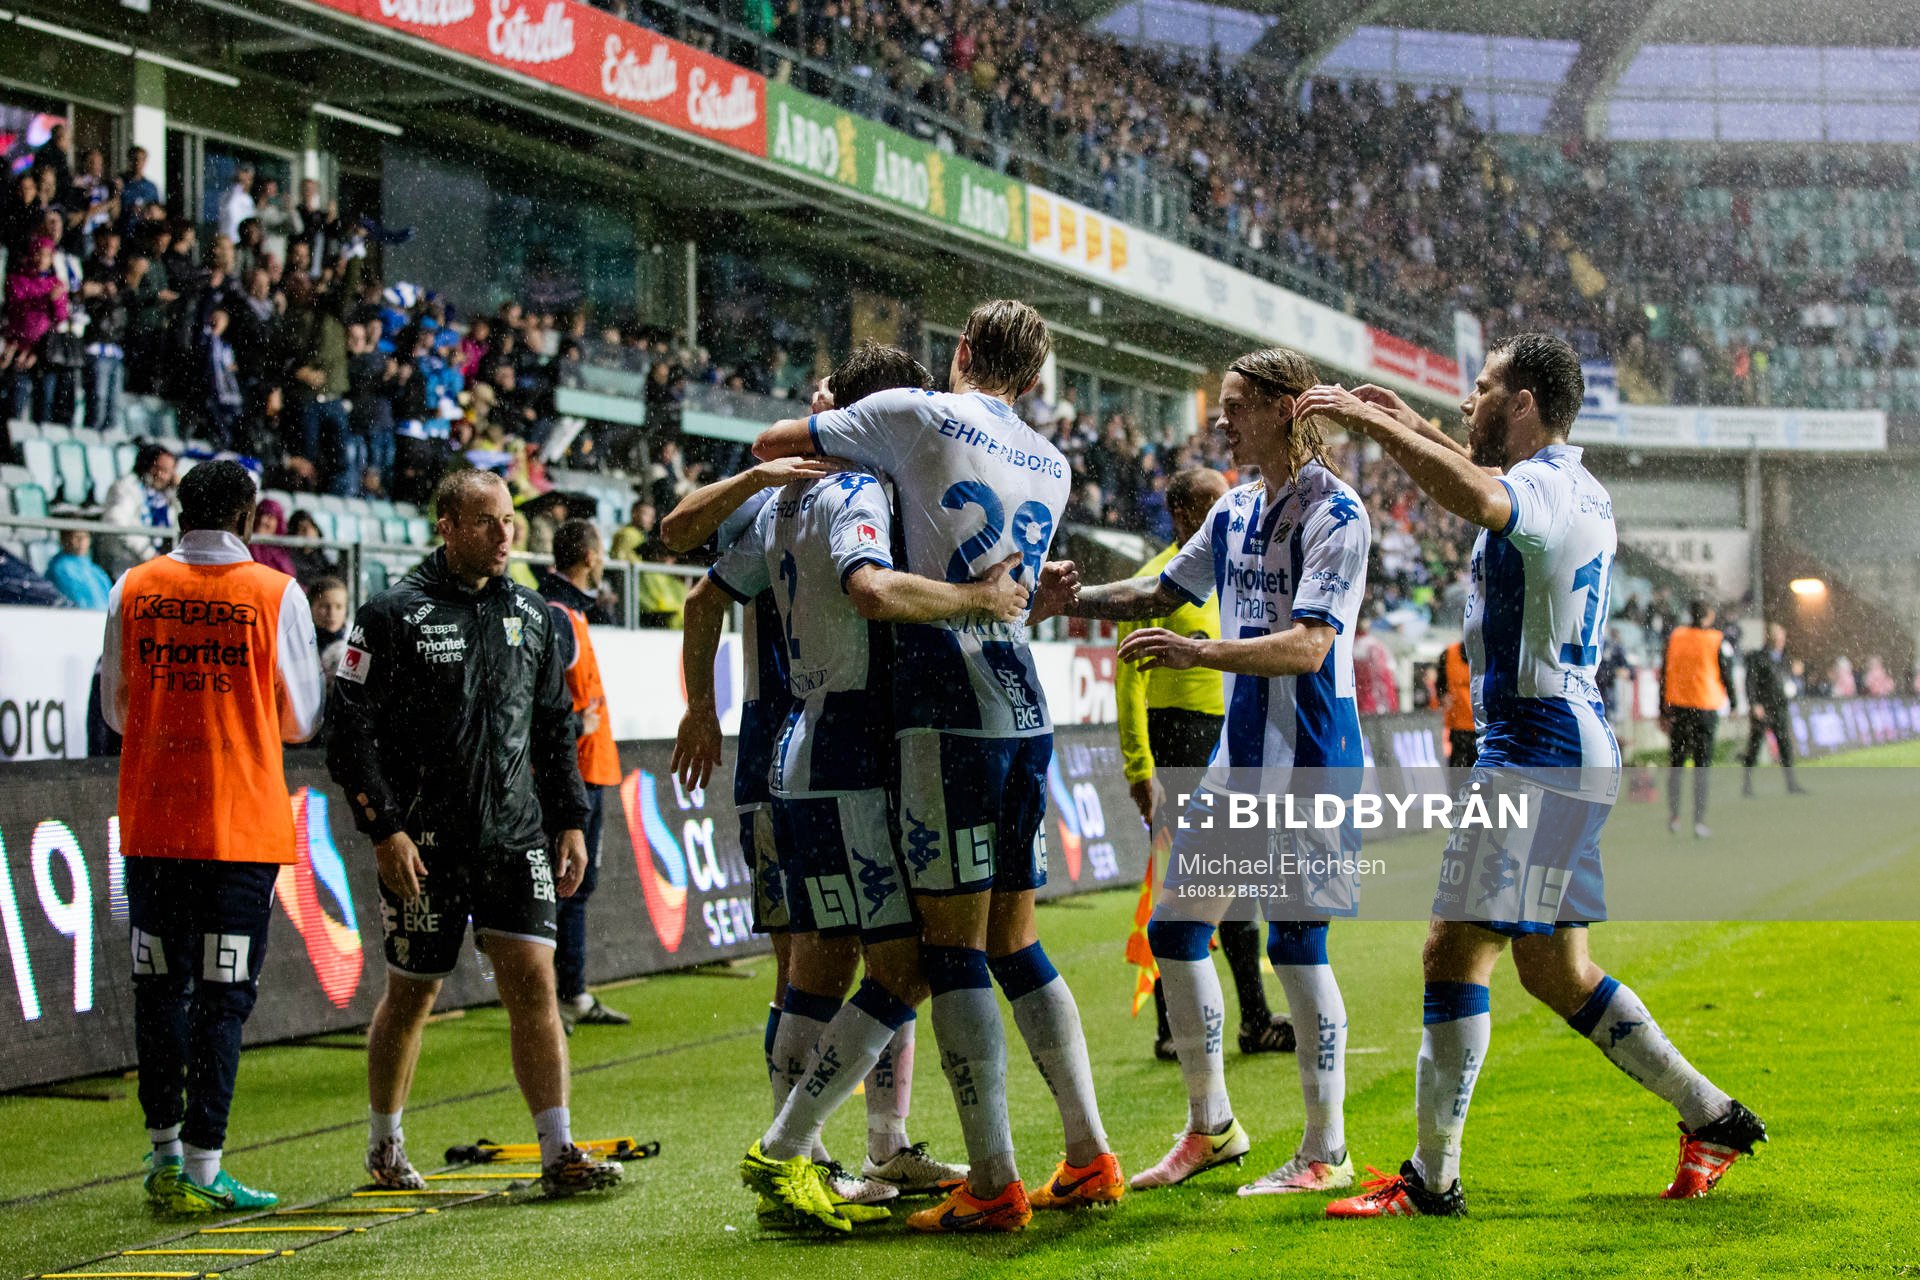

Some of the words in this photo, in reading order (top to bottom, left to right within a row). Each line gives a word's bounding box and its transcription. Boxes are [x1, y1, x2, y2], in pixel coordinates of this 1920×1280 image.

[939, 418, 1062, 479] EHRENBORG
[134, 594, 258, 626] Kappa
[1559, 550, 1616, 666] 1
[416, 637, 468, 654] Prioritet
[420, 623, 458, 635] Kappa
[139, 637, 249, 667] Prioritet
[424, 651, 463, 665] Finans
[150, 664, 232, 693] Finans
[404, 913, 440, 933] EKE
[1203, 1005, 1222, 1054] SKF
[1318, 1013, 1336, 1071] SKF
[805, 1044, 841, 1098] SKF
[947, 1050, 979, 1106] SKF
[1452, 1048, 1478, 1119] SKF
